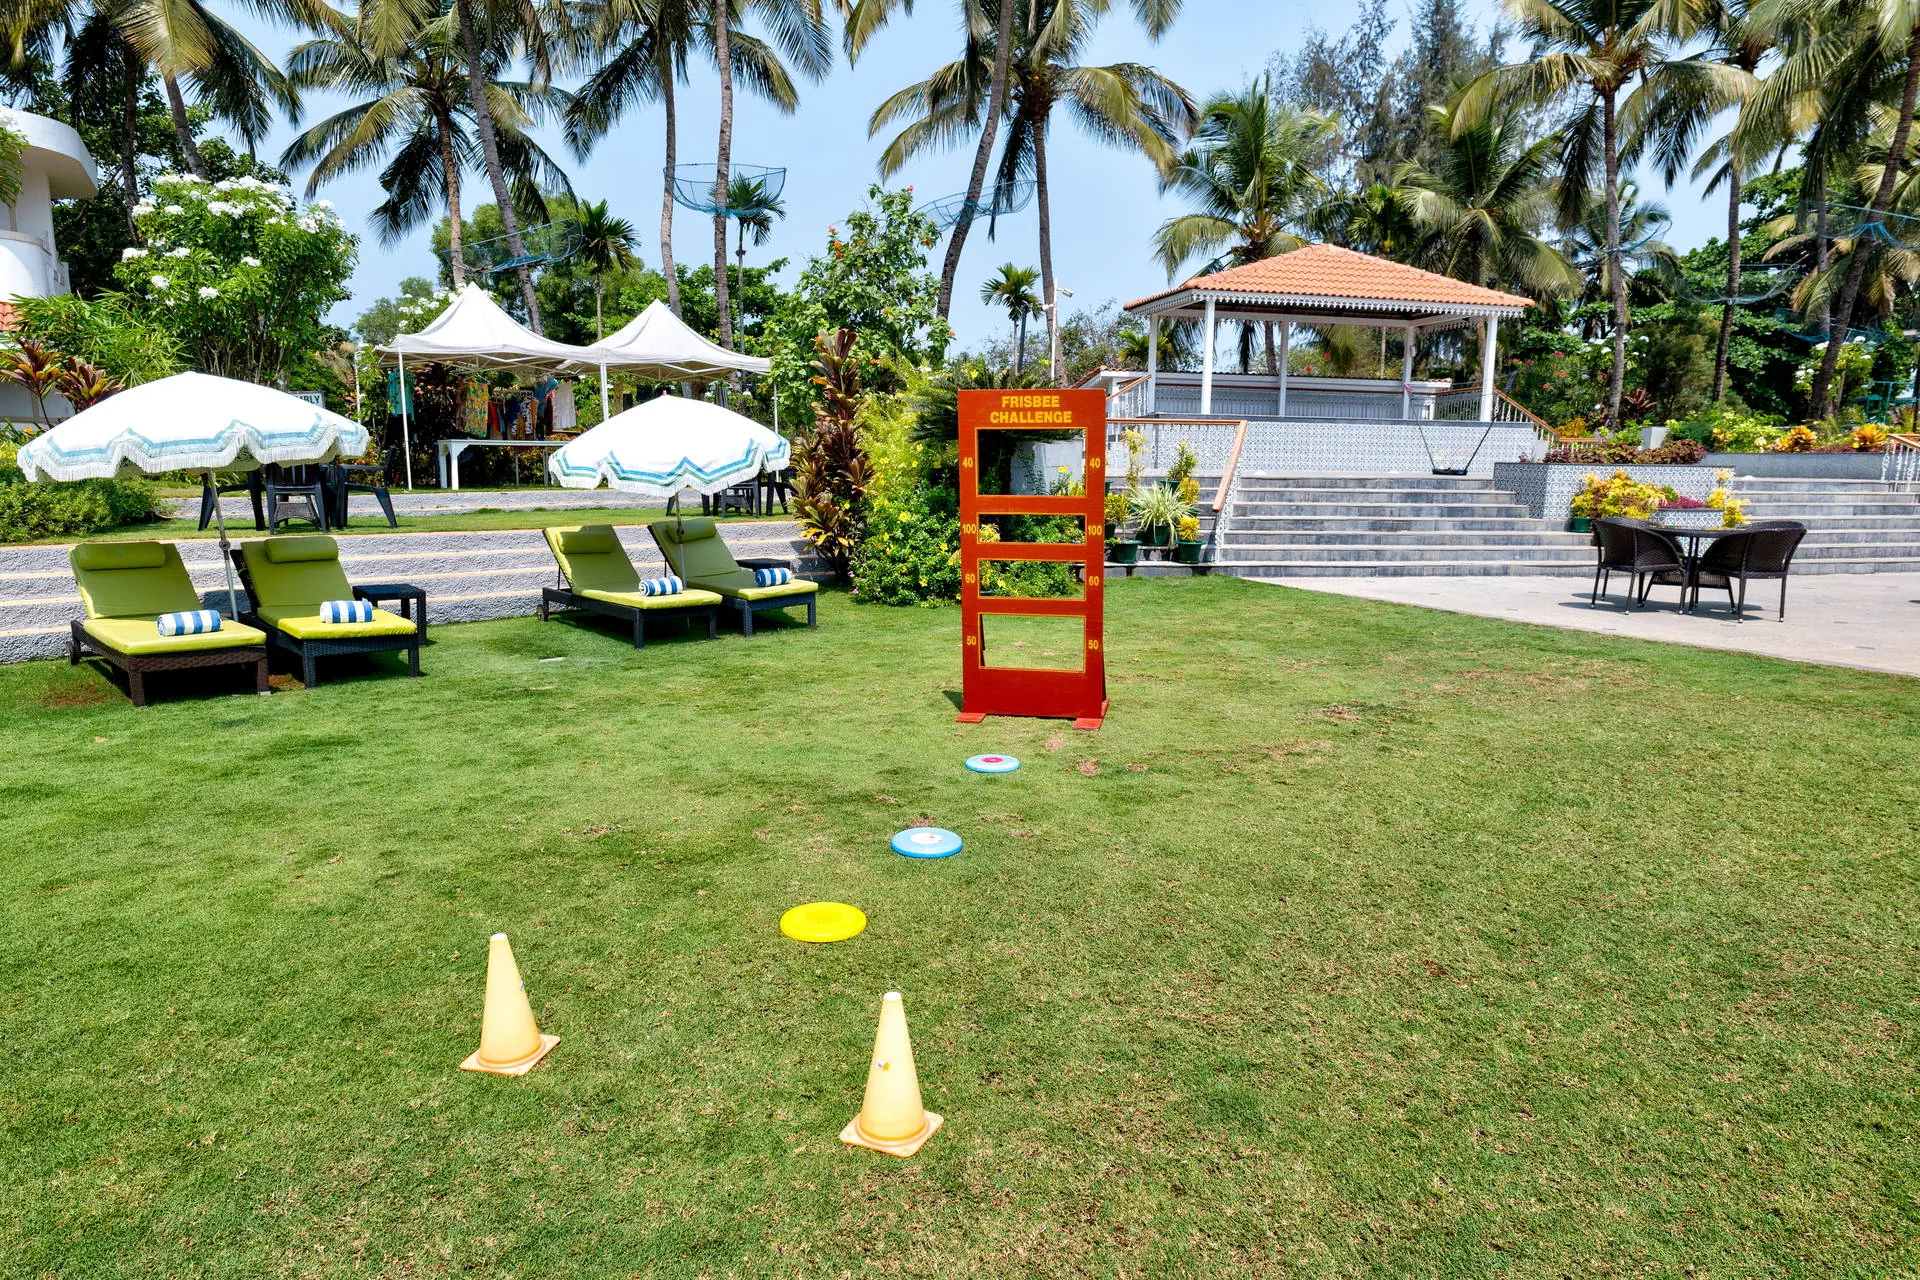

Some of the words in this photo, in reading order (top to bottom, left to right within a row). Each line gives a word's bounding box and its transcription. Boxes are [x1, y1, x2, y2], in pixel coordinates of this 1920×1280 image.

[1001, 395, 1060, 408] FRISBEE
[990, 411, 1072, 423] CHALLENGE
[962, 457, 973, 468] 40
[1089, 458, 1101, 469] 40
[962, 523, 977, 535] 100
[1087, 524, 1103, 536] 100
[965, 573, 976, 584] 60
[1088, 575, 1100, 586] 60
[966, 635, 977, 647] 50
[1088, 639, 1099, 650] 50
